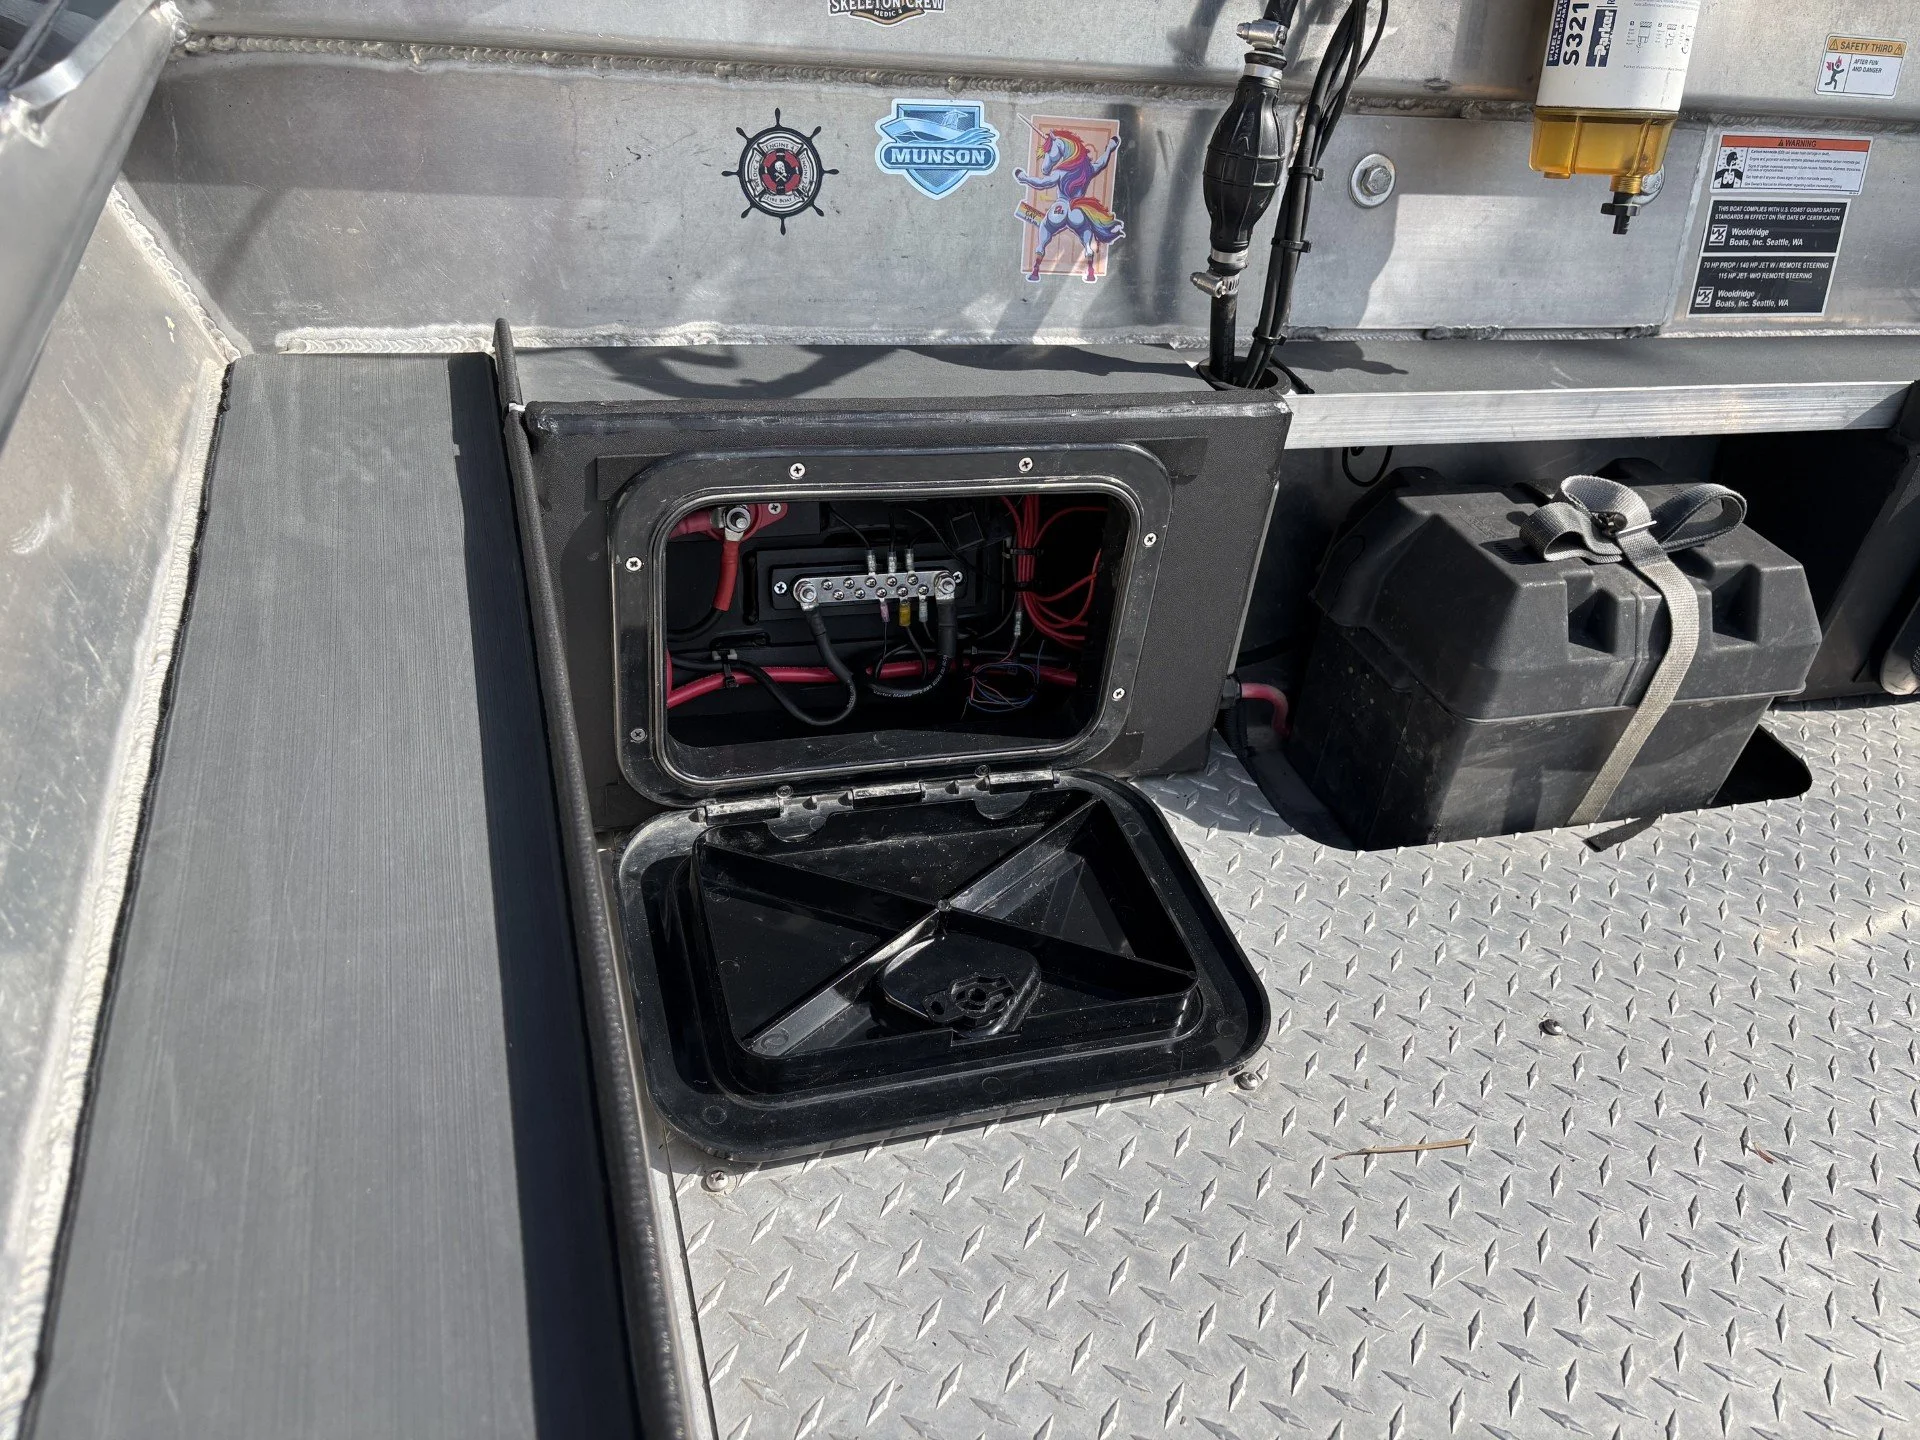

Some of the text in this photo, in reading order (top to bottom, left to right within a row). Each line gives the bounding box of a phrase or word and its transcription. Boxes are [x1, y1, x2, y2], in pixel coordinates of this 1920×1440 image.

[831, 0, 944, 12] SKELETON CREW
[873, 9, 897, 18] MEDIC
[1562, 3, 1589, 66] S321
[1593, 10, 1614, 56] Parker
[1549, 31, 1559, 61] FUEL
[1553, 34, 1562, 60] WATER
[1840, 41, 1894, 53] SAFETY THIRD
[766, 142, 789, 150] ENGINE
[890, 148, 986, 164] MUNSON
[1732, 228, 1769, 237] Wooldridge
[1729, 238, 1750, 247] Boats,
[1766, 238, 1790, 247] Seattle,
[1792, 238, 1803, 246] WA
[1718, 290, 1755, 299] Wooldridge
[1715, 300, 1736, 308] Boats,
[1751, 299, 1776, 308] Seattle,
